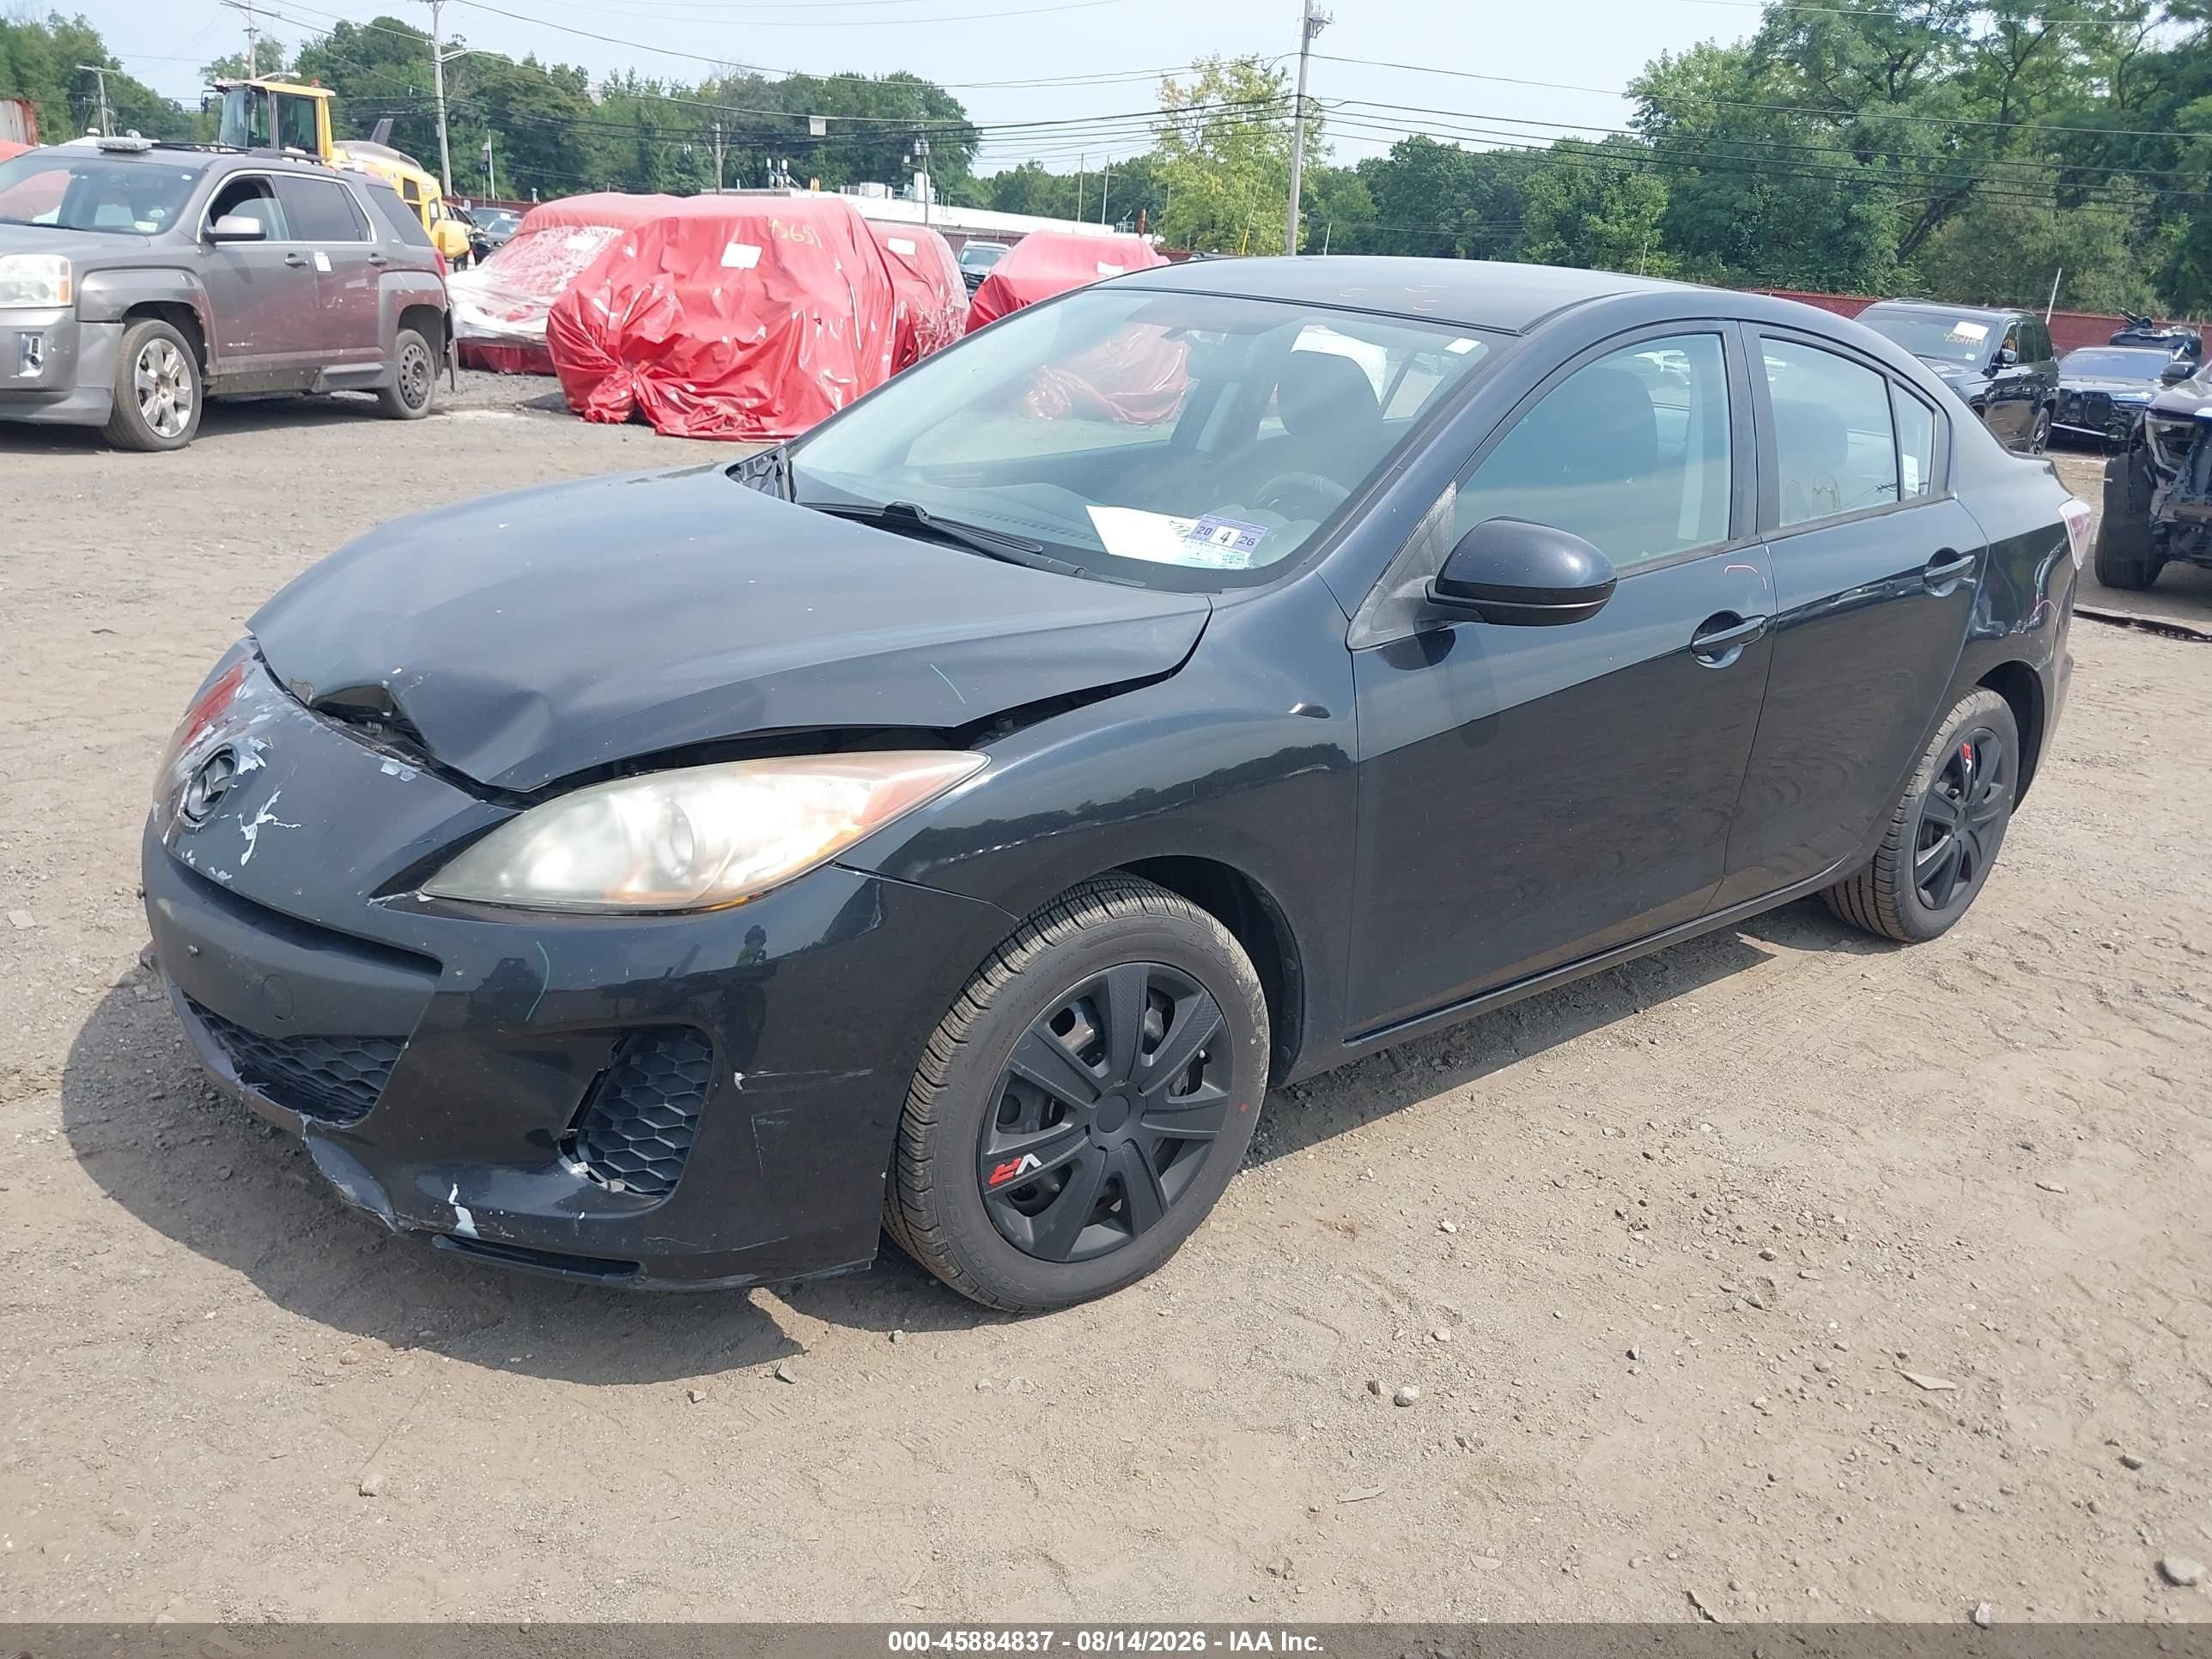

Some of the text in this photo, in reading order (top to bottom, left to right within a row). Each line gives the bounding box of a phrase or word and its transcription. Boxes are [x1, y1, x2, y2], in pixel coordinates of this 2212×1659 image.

[1196, 526, 1213, 537] 20
[1219, 531, 1232, 544] 4
[1237, 536, 1257, 546] 26
